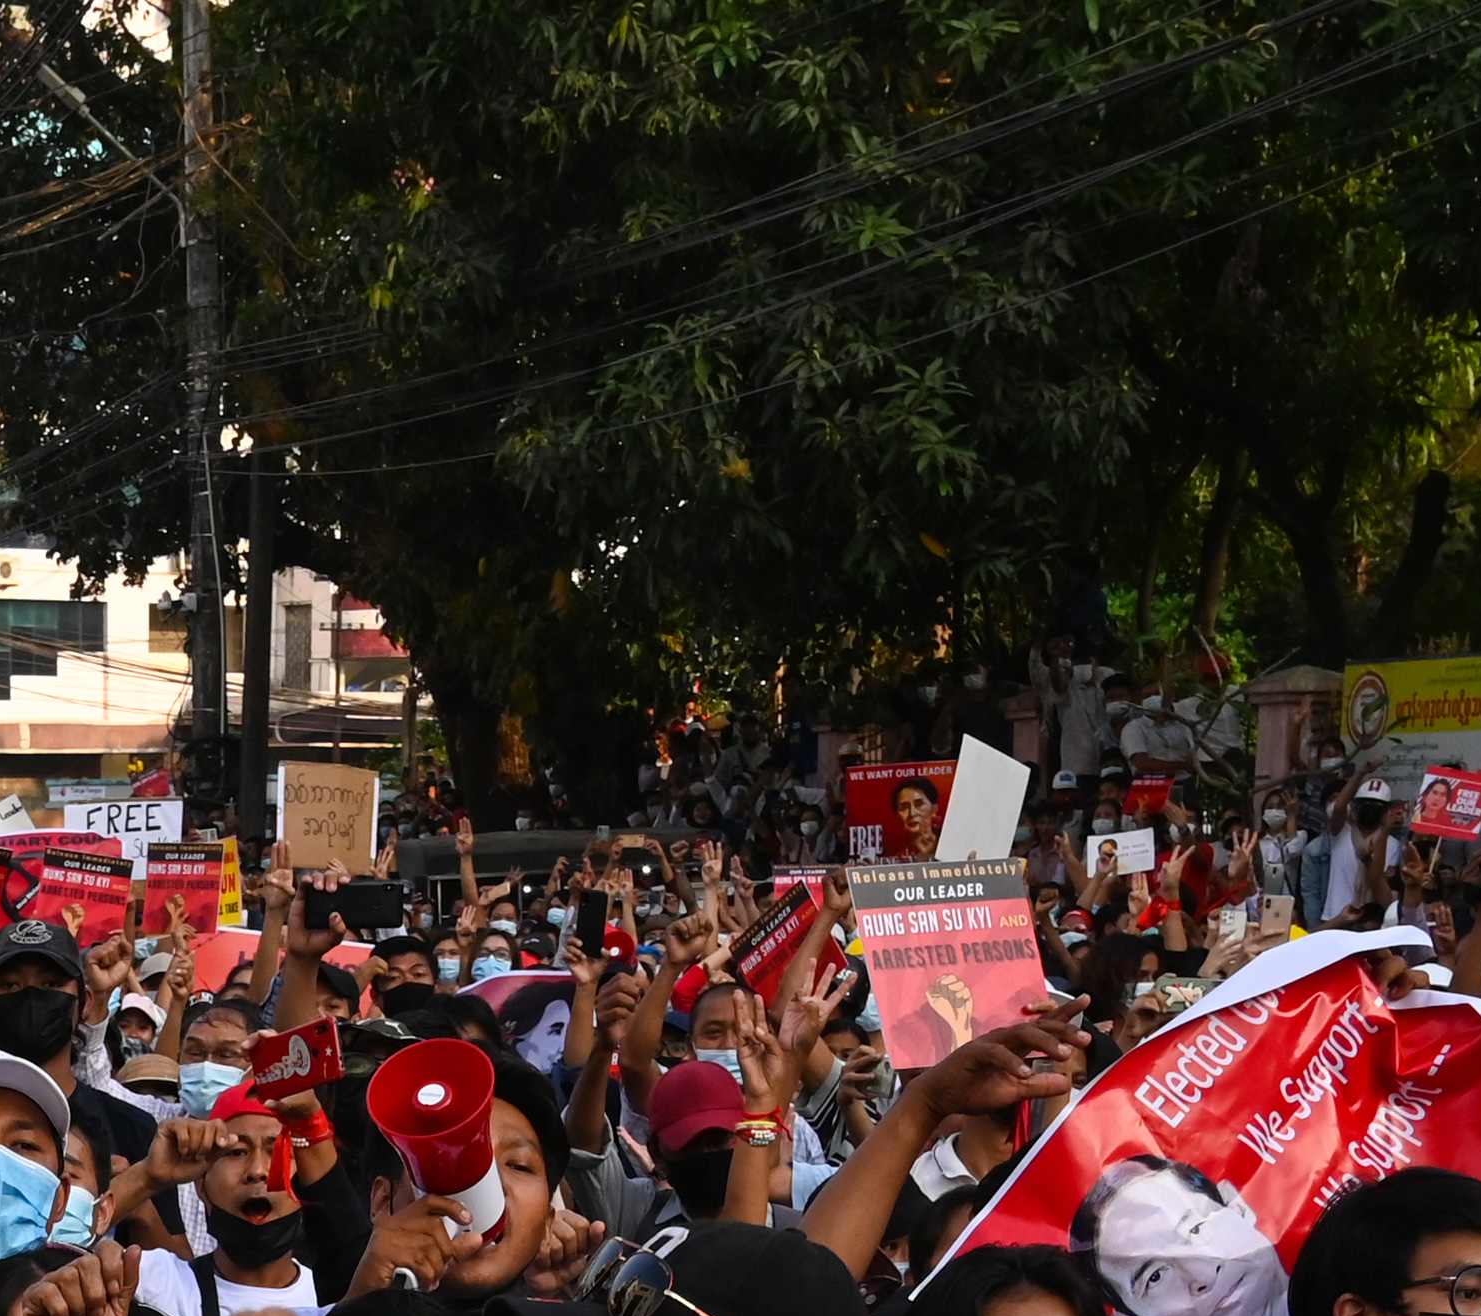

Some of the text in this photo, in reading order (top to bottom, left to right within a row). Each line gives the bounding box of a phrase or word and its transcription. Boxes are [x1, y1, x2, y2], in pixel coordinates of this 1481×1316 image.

[86, 803, 162, 835] FREE
[63, 860, 112, 873] OUR LEADER
[852, 862, 1018, 885] Release Immediately
[894, 883, 984, 902] OUR LEADER
[862, 906, 1029, 938] AUNG SAN SU KYI AND
[872, 938, 1036, 971] ARRESTED PERSONS
[1134, 1012, 1247, 1129] Elected
[1238, 999, 1379, 1165] We Support
[1347, 1080, 1443, 1181] Support
